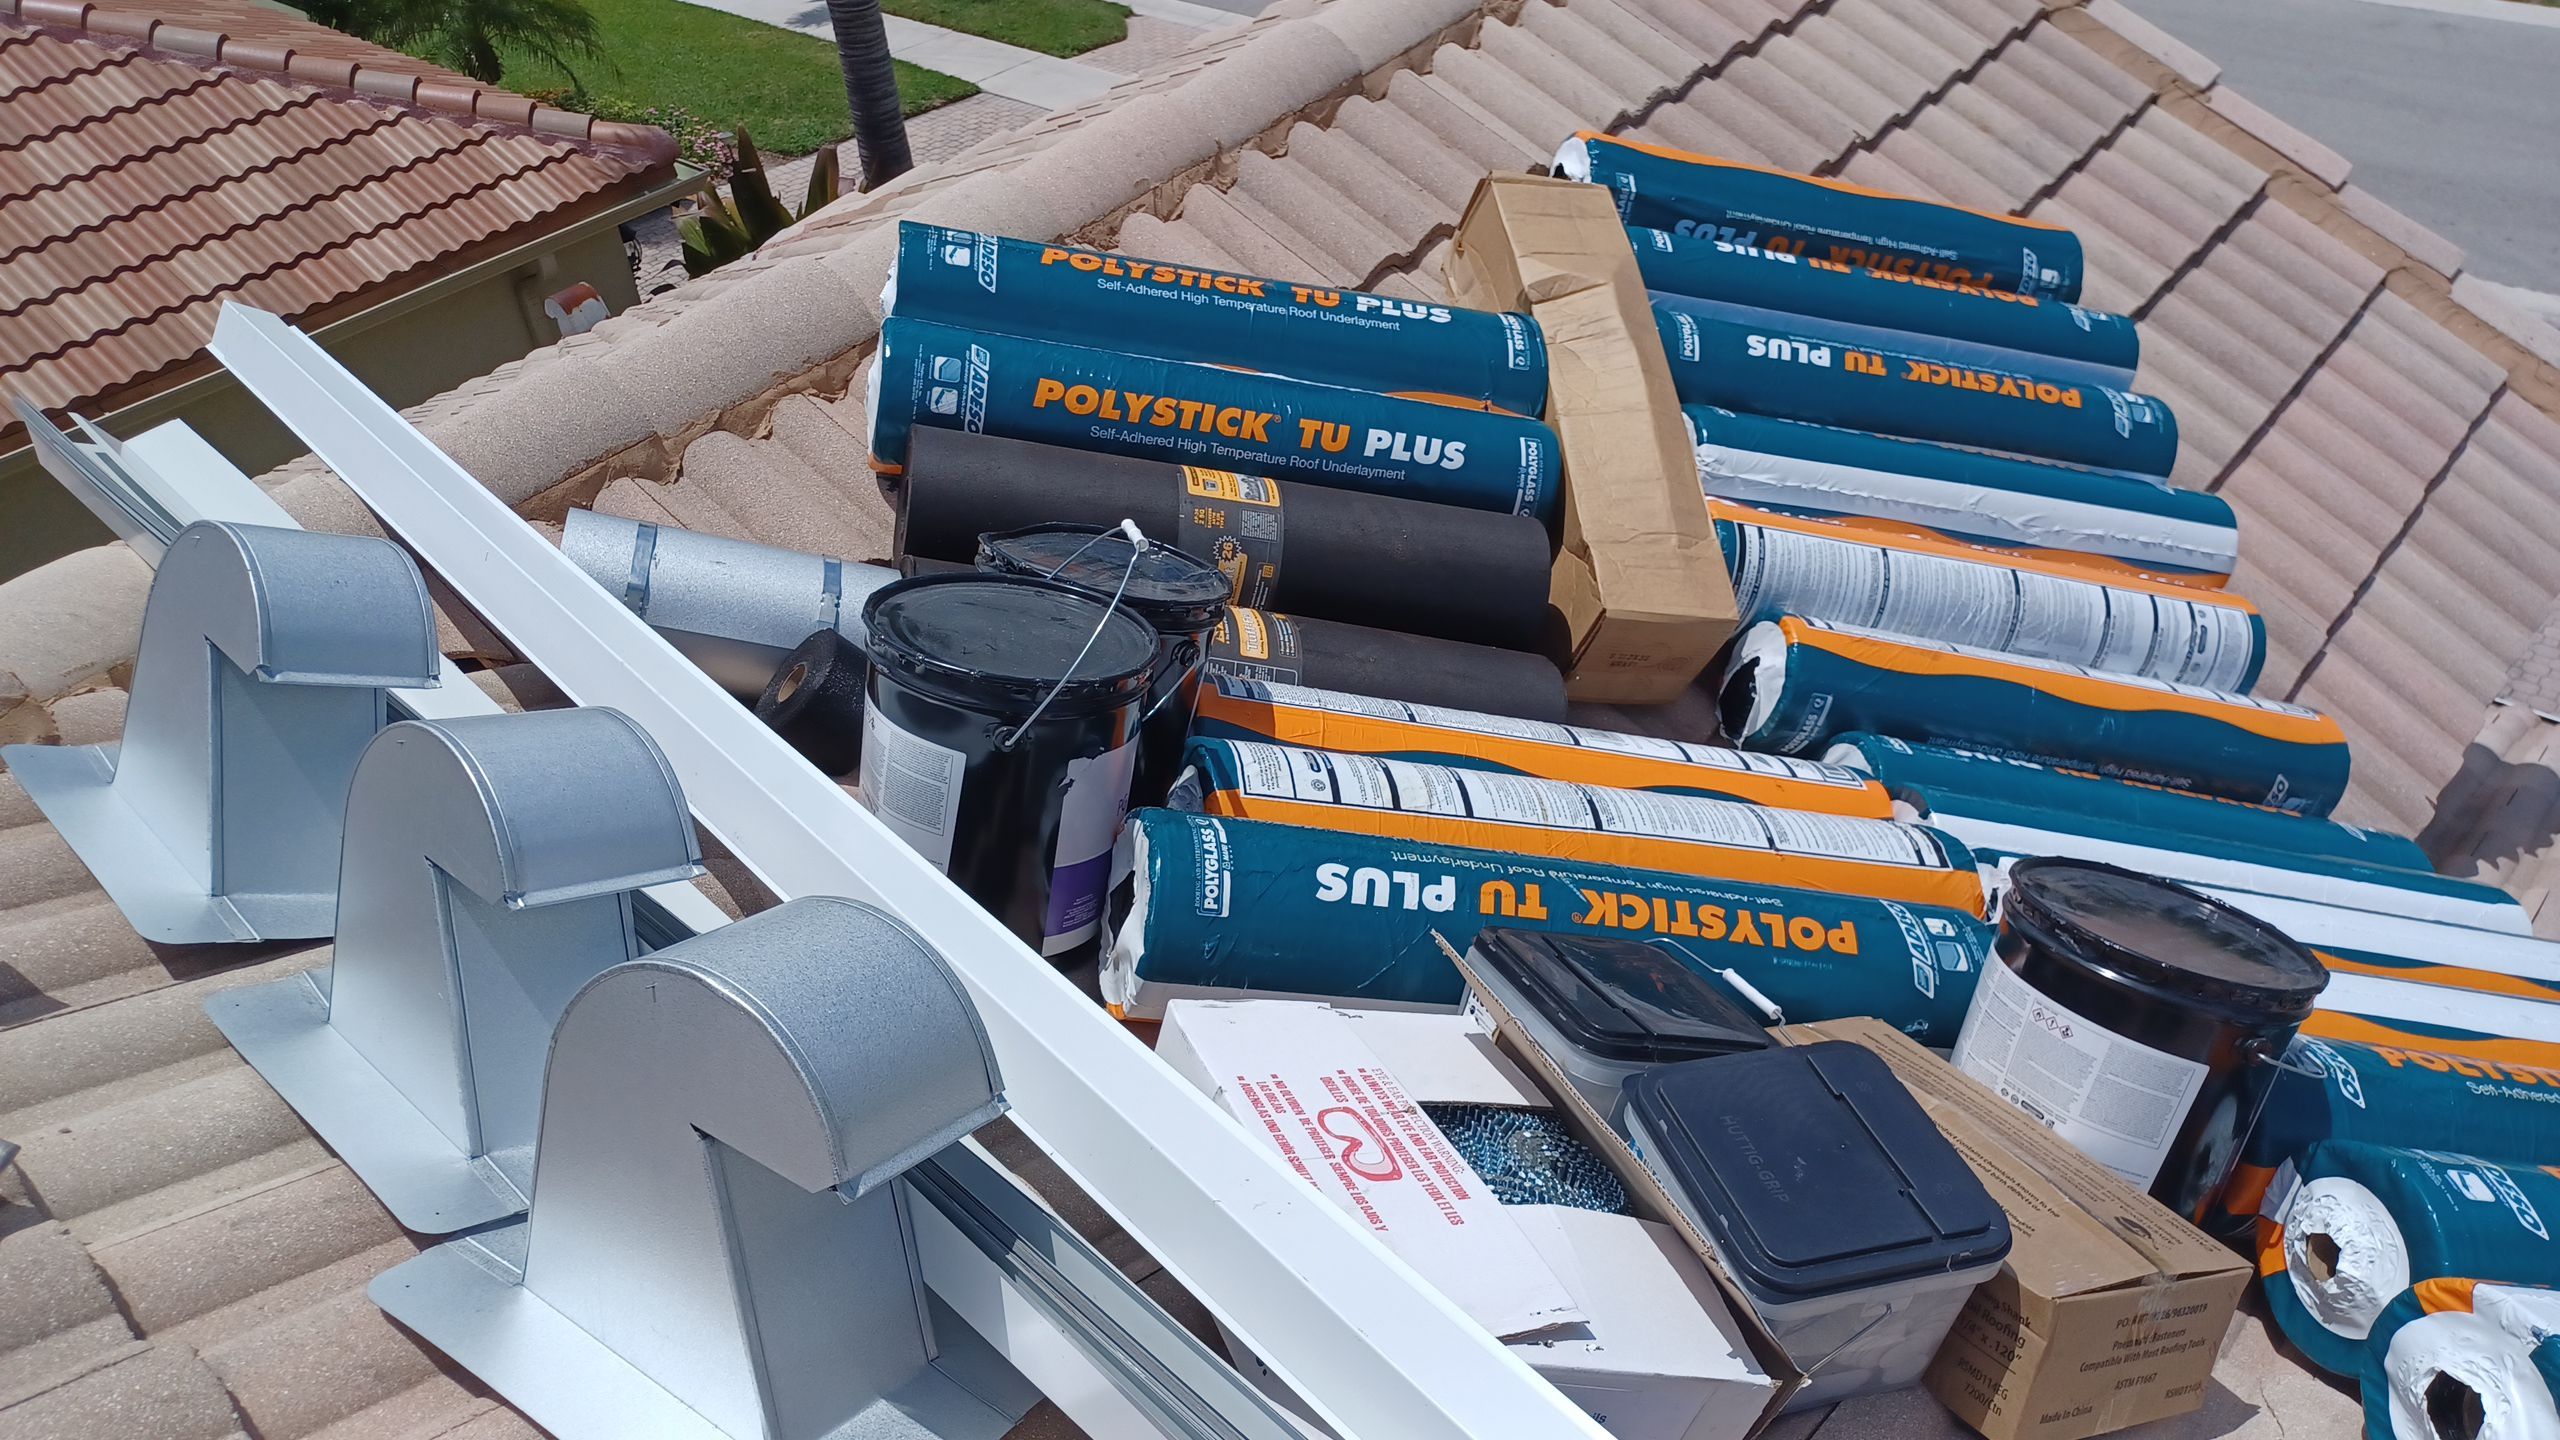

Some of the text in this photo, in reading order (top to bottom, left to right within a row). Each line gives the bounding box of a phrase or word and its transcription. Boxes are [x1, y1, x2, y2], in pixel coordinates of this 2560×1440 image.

[1041, 248, 1451, 323] POLYSTICK TU PLUS
[1097, 278, 1400, 331] Self-Adhered High Temperature Roof Underlayment
[1747, 335, 1831, 367] PLUS
[1845, 351, 1887, 376] TU
[1090, 425, 1406, 481] Self-Adhered High Temperature Roof Underlayment
[1299, 418, 1350, 452] TU
[1363, 428, 1467, 470] PLUS
[1524, 441, 1538, 502] POLYGLASS
[1222, 542, 1234, 559] 26
[1201, 828, 1219, 909] POLYGLASS
[1391, 851, 1502, 874] Underlayment
[1505, 864, 1545, 878] Roof
[1548, 869, 1646, 889] Temperature
[1315, 863, 1455, 912] PLUS
[1479, 880, 1547, 920] TU
[1256, 1081, 1286, 1114] LAS OREJAS
[1273, 1081, 1287, 1089] NO
[1320, 1076, 1349, 1103] OREILLES
[1239, 1083, 1271, 1118] AUGENGLAS
[1264, 1119, 1280, 1133] UND
[1280, 1090, 1306, 1115] OLVIDEN
[1299, 1118, 1313, 1126] DE
[1360, 1074, 1471, 1201] ALWAYS WEAR EYE AND EAR PROTECTION
[1362, 1104, 1395, 1138] TOUJOURS
[1305, 1127, 1335, 1160] PROTEGER
[1386, 1137, 1420, 1170] PROTEGER
[1431, 1140, 1465, 1174] WARNING:
[1720, 1116, 1790, 1202] HUTTIG-GRIP
[1329, 1162, 1359, 1191] SIEMPRE
[1412, 1169, 1430, 1182] LES
[1423, 1181, 1446, 1201] YEUX
[1956, 1137, 1983, 1159] contains
[1984, 1158, 2015, 1183] chemicals
[2016, 1182, 2039, 1202] known
[2048, 1208, 2060, 1218] the
[1977, 1162, 1991, 1173] and
[1990, 1172, 2007, 1186] birth
[2007, 1185, 2032, 1205] defects
[2032, 1204, 2041, 1212] or
[1351, 1193, 1368, 1205] LOS
[1361, 1206, 1382, 1224] OJOS
[1437, 1201, 1455, 1212] ET
[1444, 1210, 1464, 1226] LES
[1982, 1309, 2026, 1348] Roofing
[2000, 1302, 2030, 1328] Shank
[2079, 1337, 2206, 1373] Compatible With Most Roofing Tools
[2114, 1373, 2158, 1390] ASTM F1667
[1964, 1382, 2002, 1416] 7200/Ctn
[2039, 1405, 2093, 1424] Made In China
